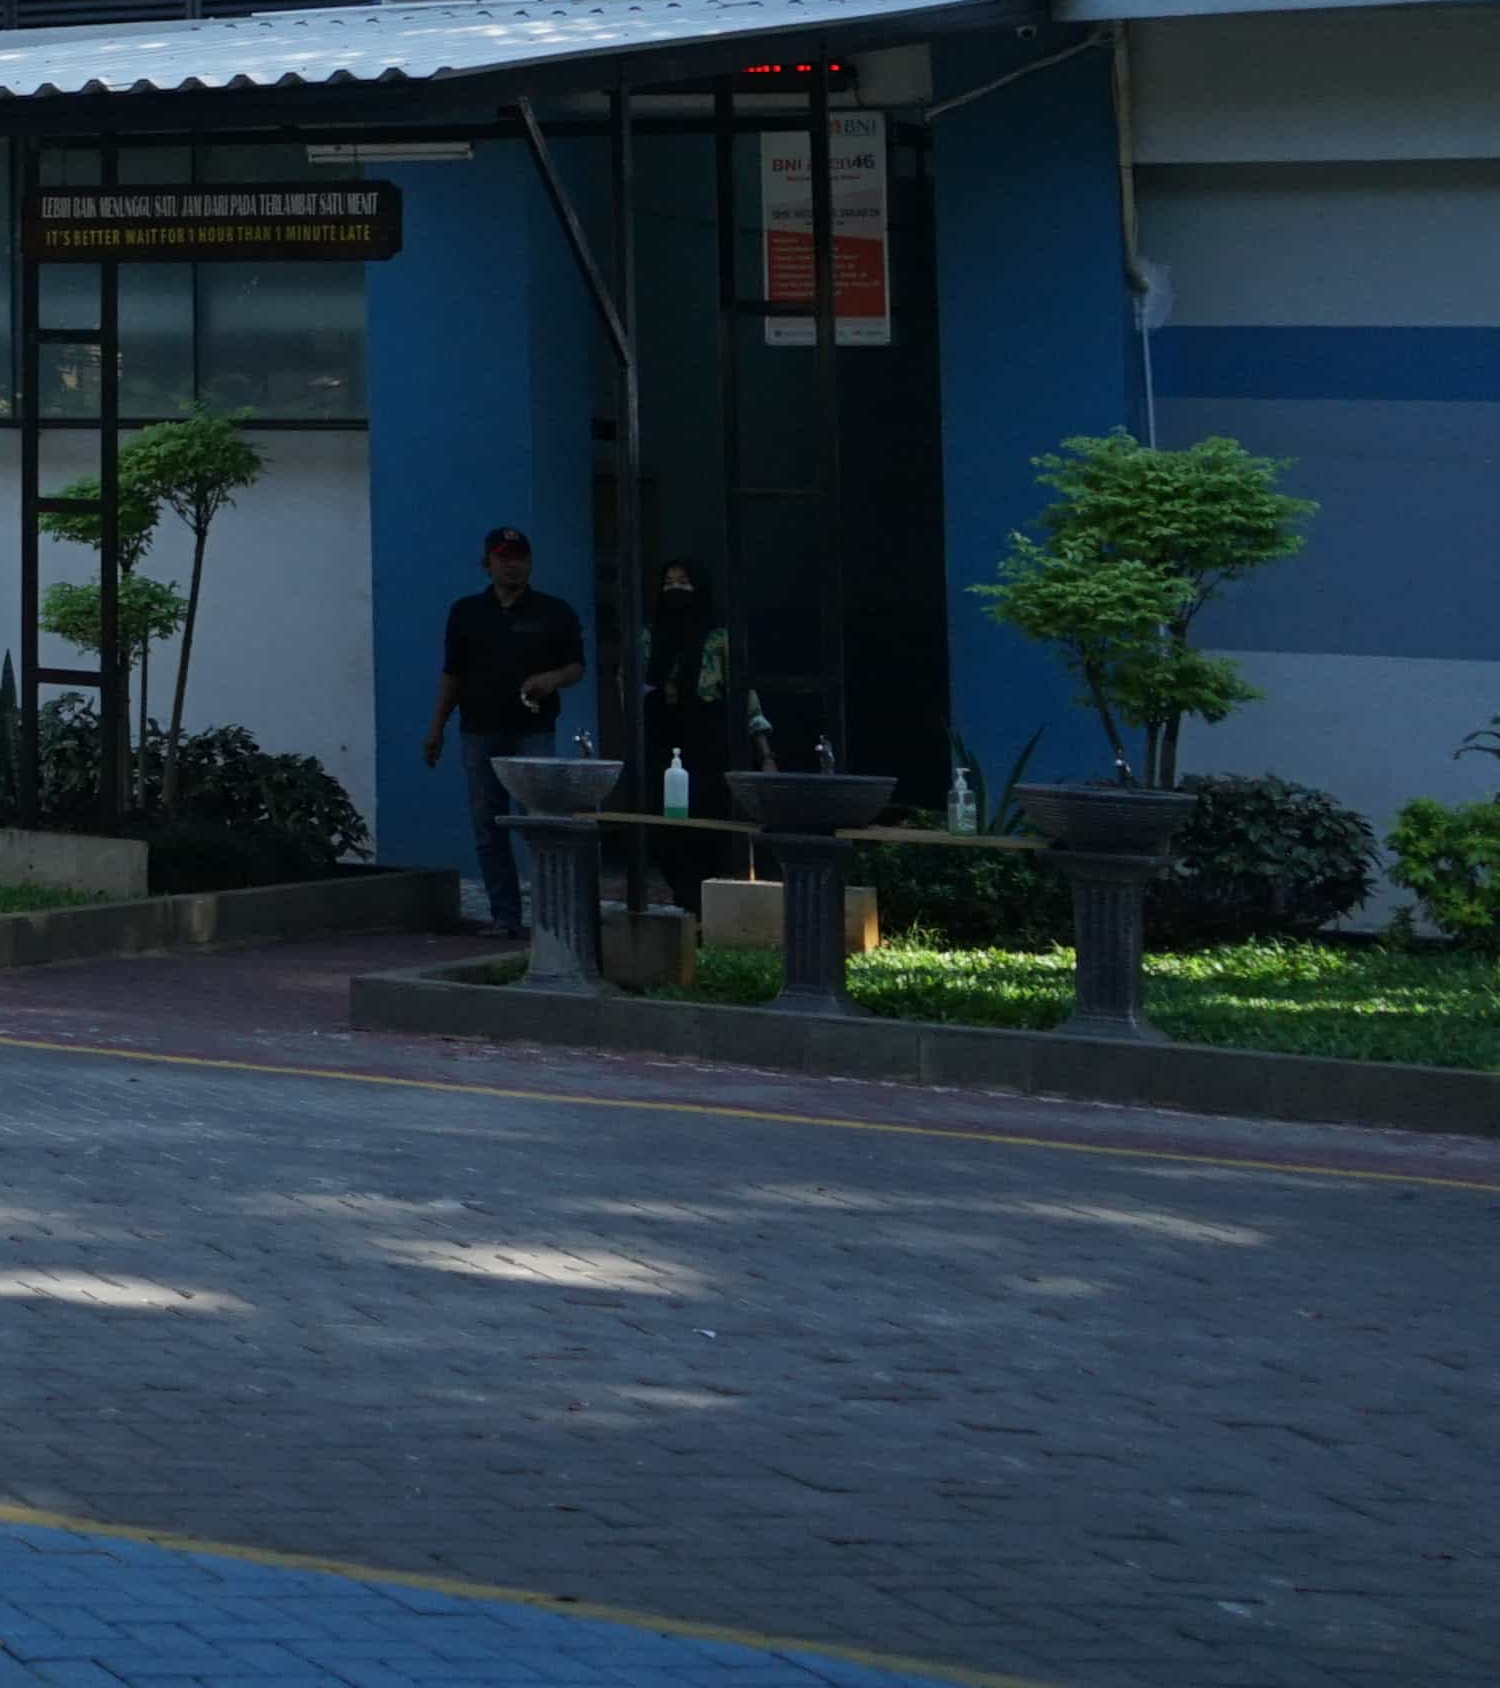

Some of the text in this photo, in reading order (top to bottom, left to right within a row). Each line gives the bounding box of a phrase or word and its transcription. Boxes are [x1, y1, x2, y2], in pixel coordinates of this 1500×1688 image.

[845, 120, 877, 136] BNI
[772, 158, 802, 173] BNI
[154, 195, 180, 217] SATU
[319, 193, 347, 215] SATU
[46, 223, 372, 246] IT'S BETTER WAIT FOR 1 HOUR THAN 1 MINUTE LATE
